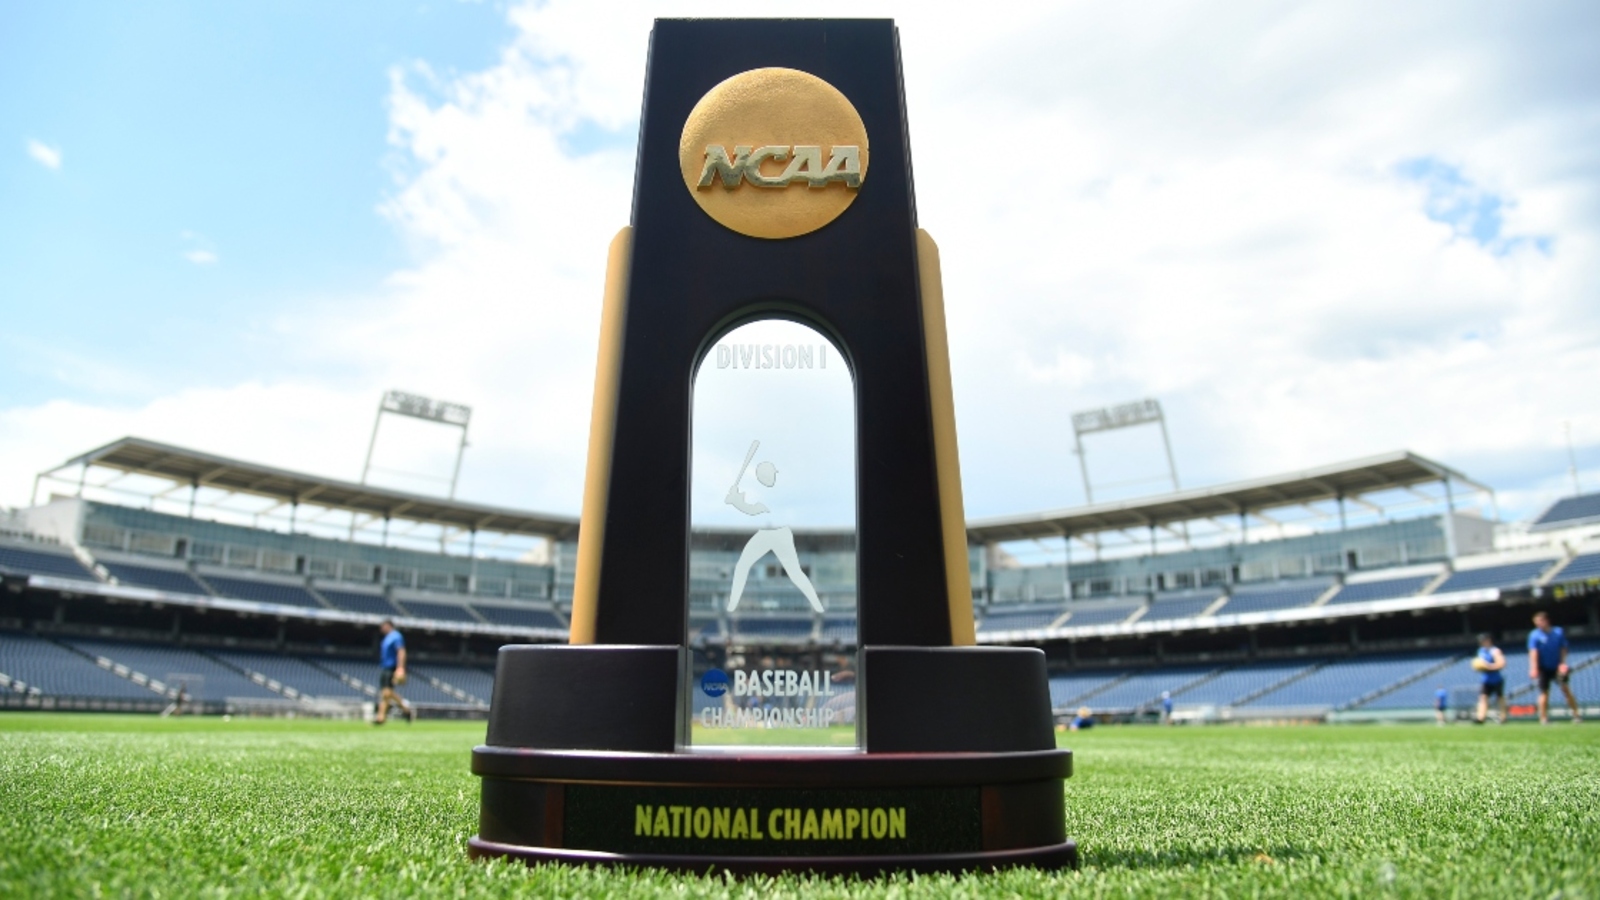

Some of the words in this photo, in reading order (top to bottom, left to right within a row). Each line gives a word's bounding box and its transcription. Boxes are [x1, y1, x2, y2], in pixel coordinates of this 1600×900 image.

[697, 144, 861, 190] NCAA
[716, 344, 814, 370] DIVISION
[819, 344, 827, 370] I
[733, 669, 835, 697] BASEBALL
[701, 706, 834, 729] CHAMPIONSHIP
[635, 804, 763, 839] NATIONAL
[768, 807, 906, 839] CHAMPION
